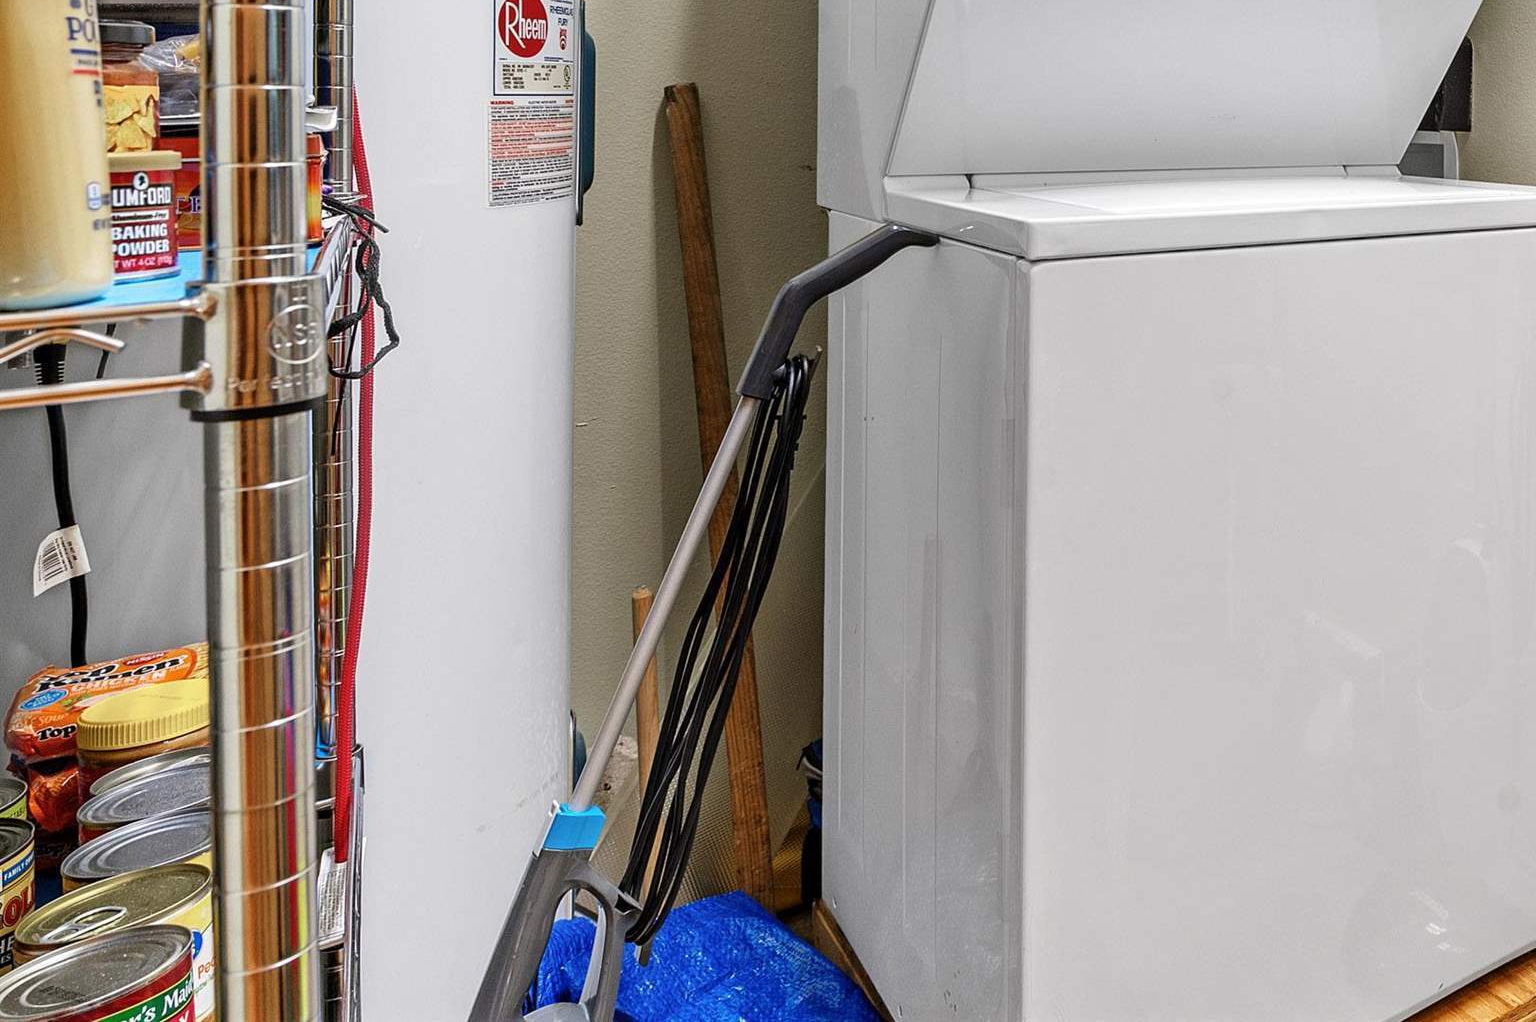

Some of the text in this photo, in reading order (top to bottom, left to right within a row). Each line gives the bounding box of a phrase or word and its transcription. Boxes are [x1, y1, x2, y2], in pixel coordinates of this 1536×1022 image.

[112, 186, 171, 207] UMFORD
[111, 223, 168, 241] BAKING
[71, 671, 166, 692] CHICKEN
[37, 724, 78, 741] Top
[4, 862, 26, 882] FAMILY
